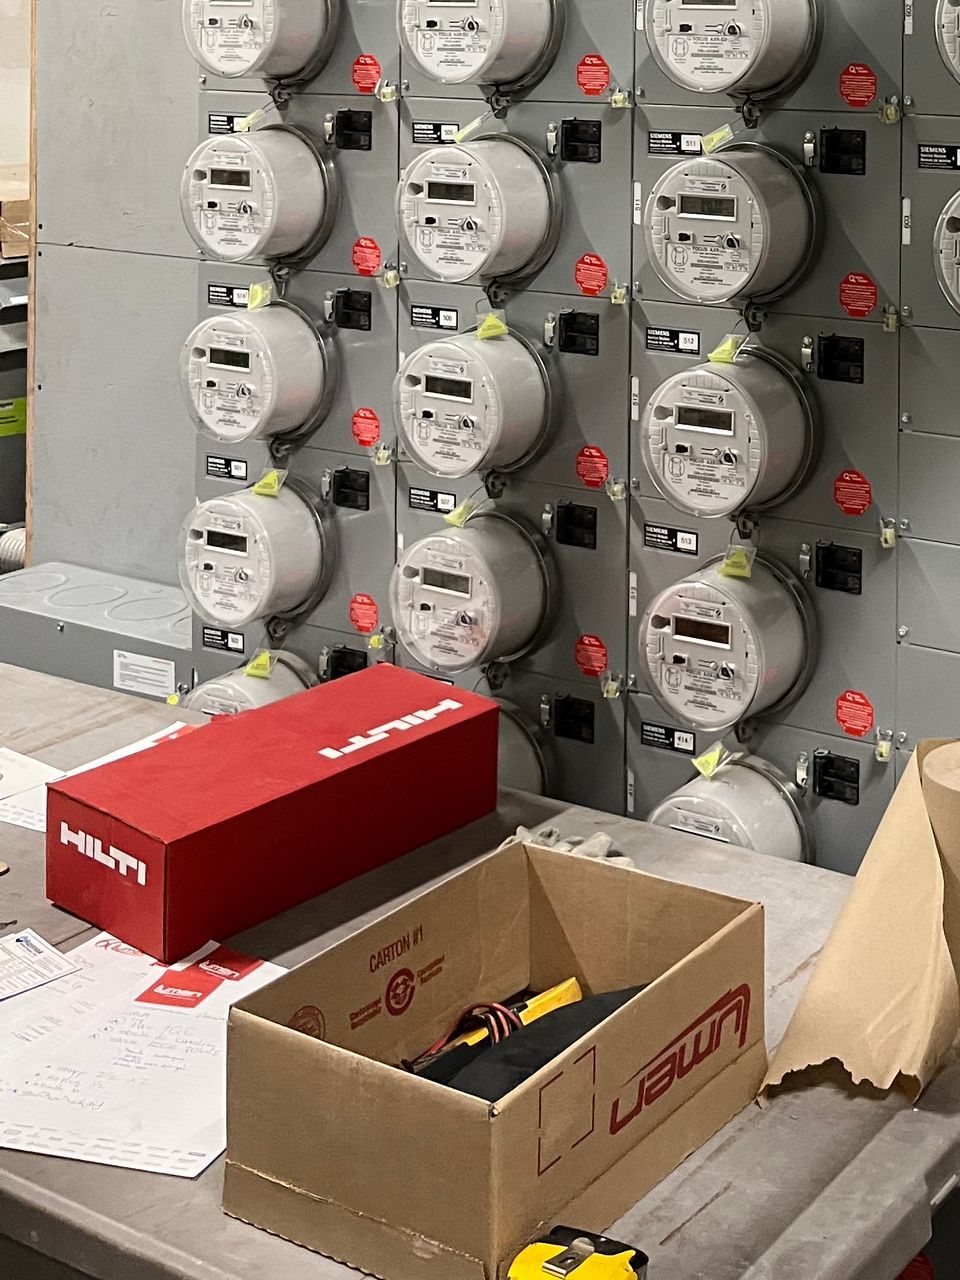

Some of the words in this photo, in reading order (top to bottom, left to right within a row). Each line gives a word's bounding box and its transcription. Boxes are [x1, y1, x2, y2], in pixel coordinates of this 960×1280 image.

[685, 140, 696, 148] 511
[920, 146, 947, 154] SIEMENS
[683, 337, 695, 345] 512
[681, 537, 692, 545] 513
[317, 698, 463, 759] HILTI
[60, 820, 147, 886] HILTI
[369, 932, 410, 973] CARTON
[412, 924, 424, 946] #1
